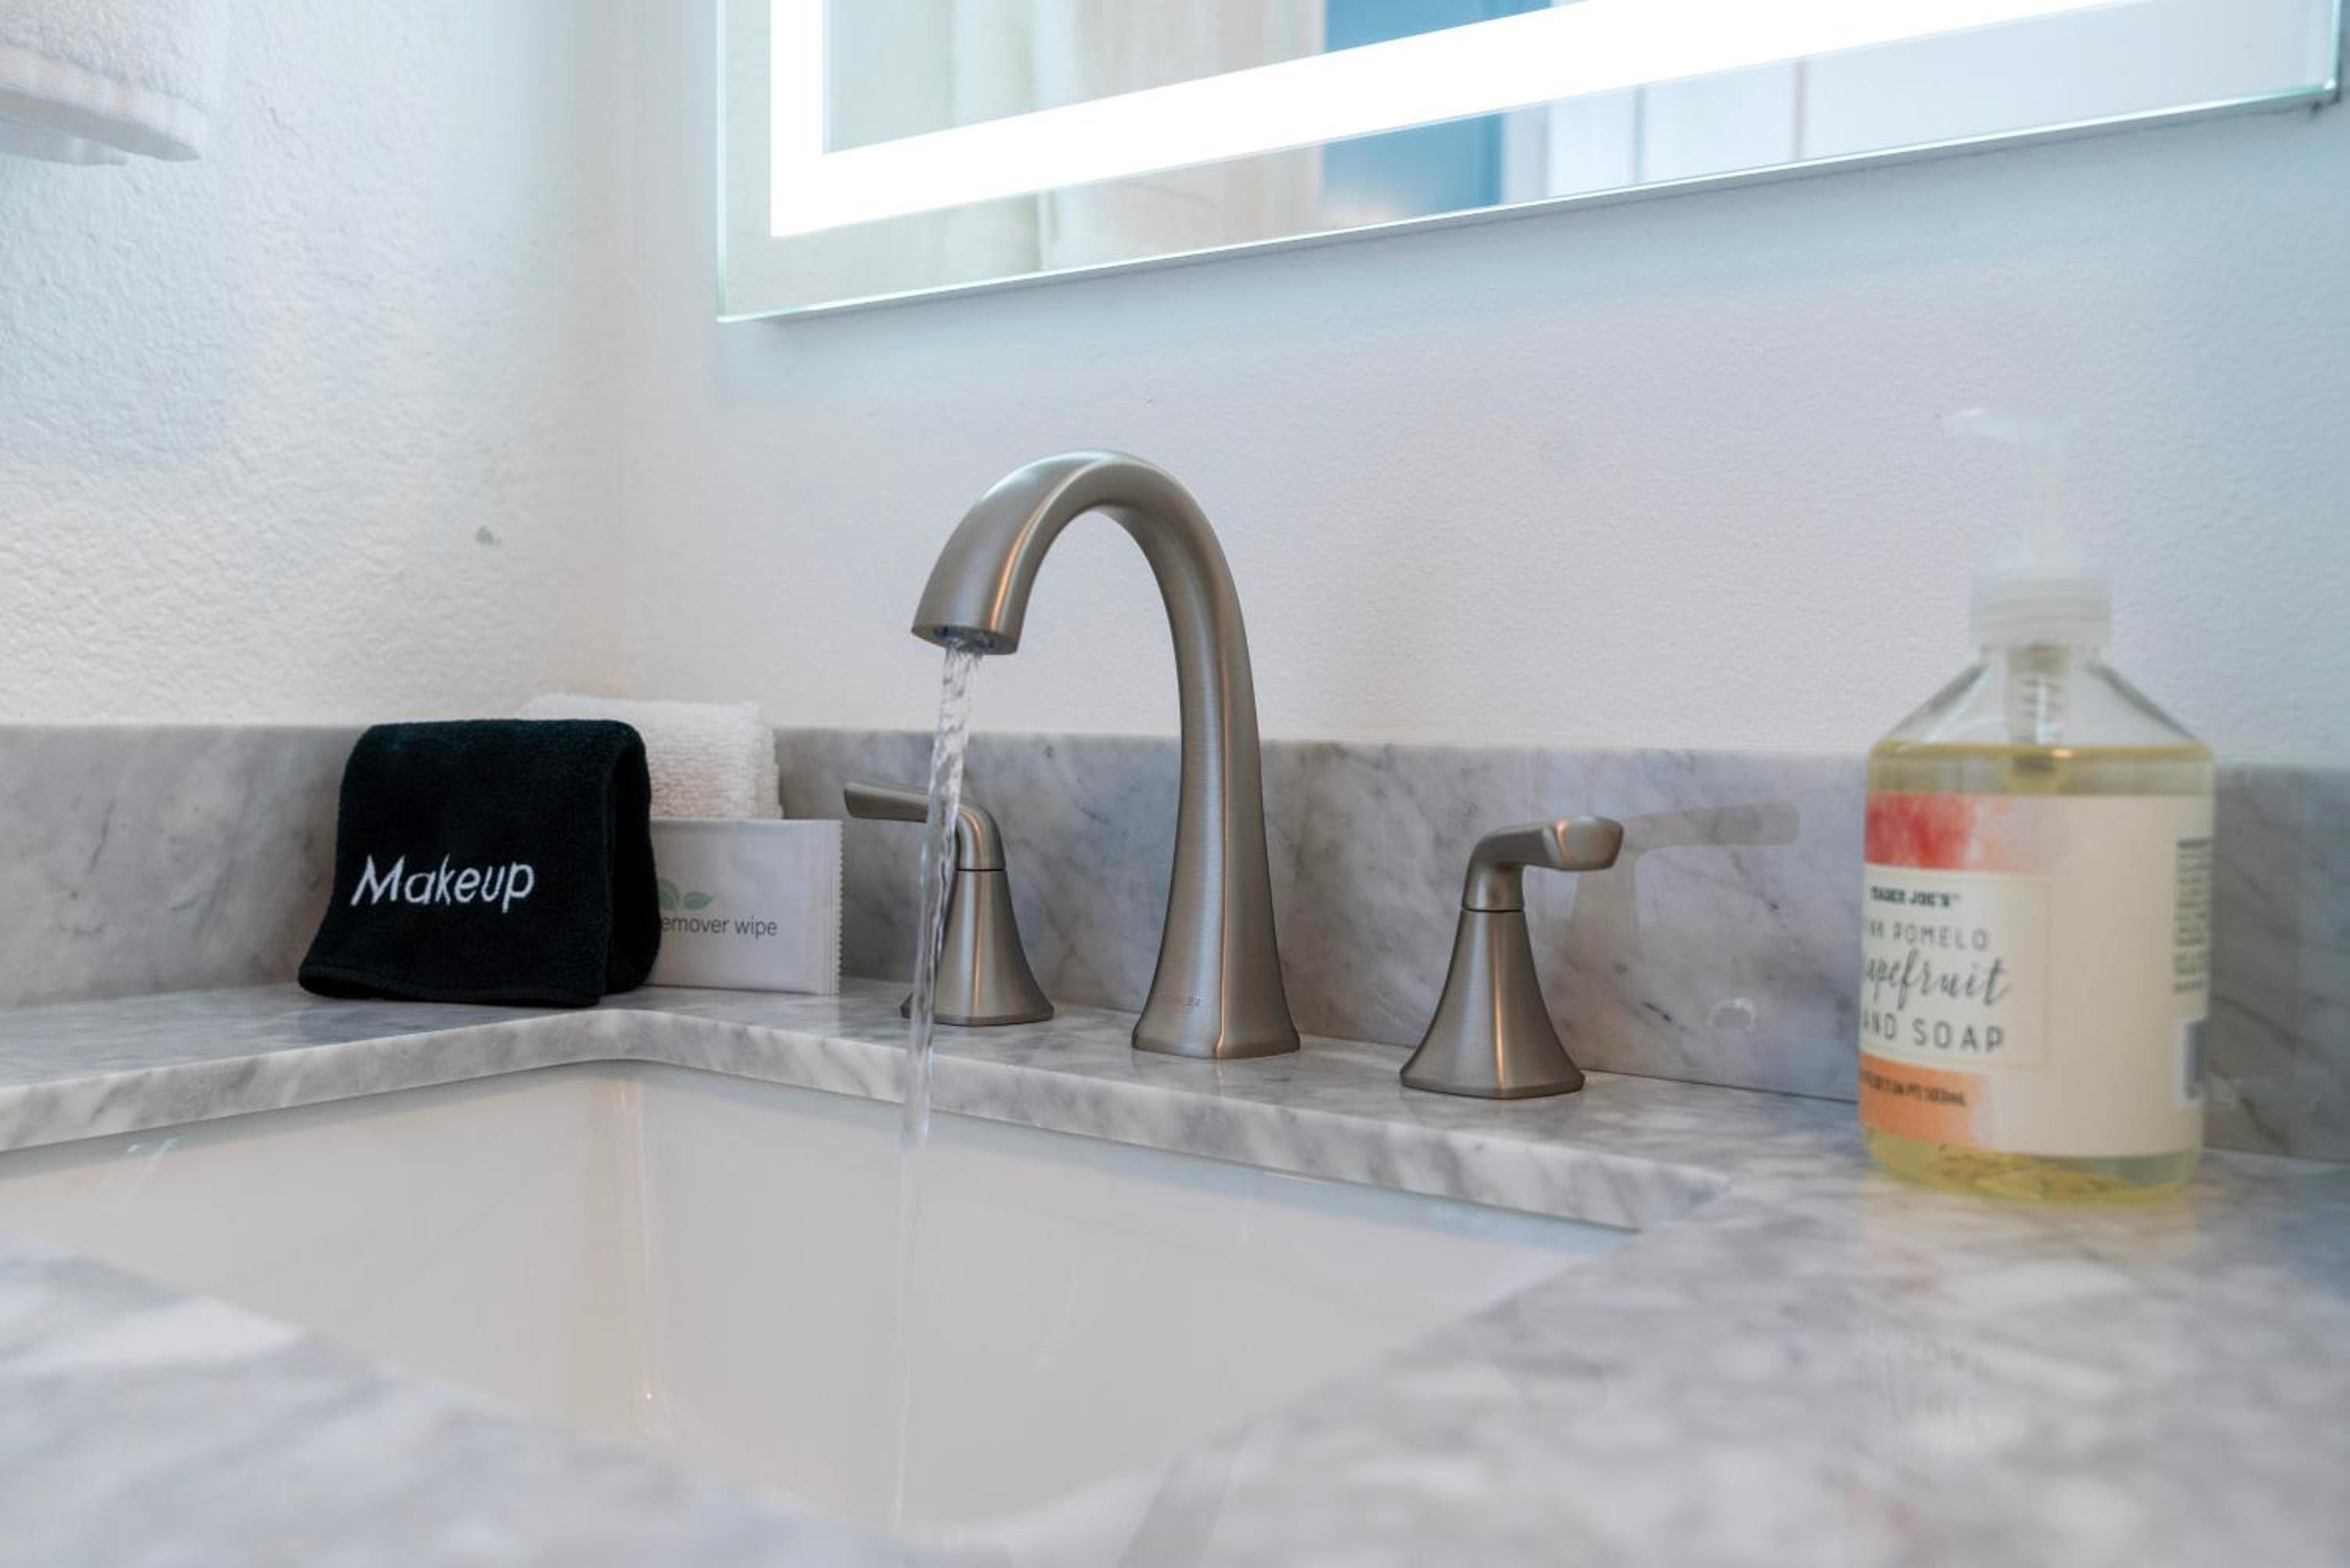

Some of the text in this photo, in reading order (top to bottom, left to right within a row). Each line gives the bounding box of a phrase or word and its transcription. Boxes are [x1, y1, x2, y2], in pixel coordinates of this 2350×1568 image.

[350, 854, 536, 914] Makeup
[662, 915, 779, 940] emover wipe
[1893, 921, 1990, 951] POMELO
[1866, 948, 2016, 1010] apefruit
[1863, 1008, 2005, 1053] AND SOAP
